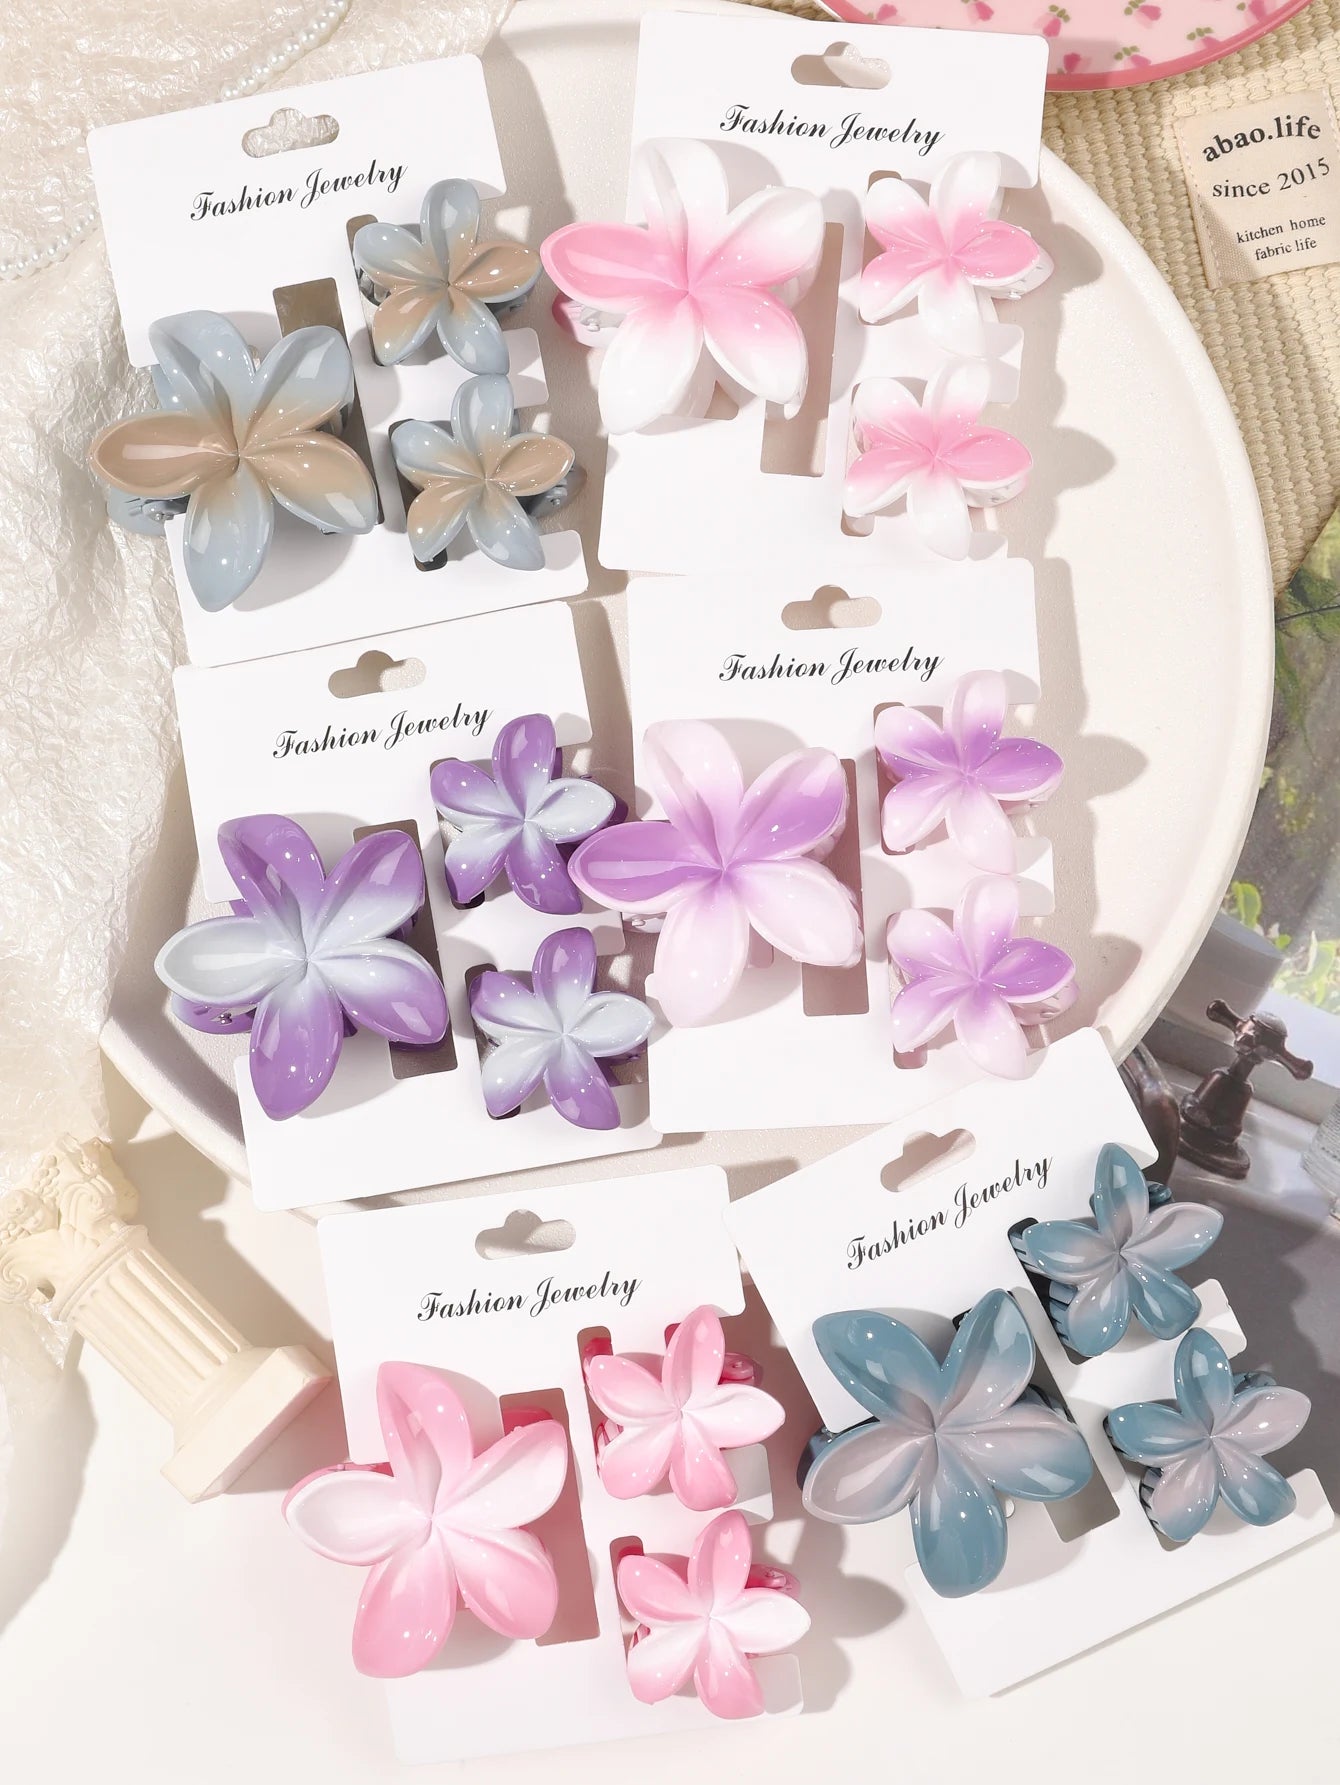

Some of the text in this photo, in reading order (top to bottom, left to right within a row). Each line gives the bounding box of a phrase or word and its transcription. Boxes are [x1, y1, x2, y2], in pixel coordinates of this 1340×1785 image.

[720, 104, 946, 157] Fashion Jewelry
[1202, 114, 1321, 162] abao.life
[190, 158, 408, 221] Fashion Jewelry
[1212, 157, 1330, 198] since 2015
[1236, 215, 1327, 244] kitchen home
[1255, 237, 1318, 261] fabric life
[718, 646, 944, 685] Fashion Jewelry
[272, 702, 493, 760] Fashion Jewelry
[847, 1155, 1053, 1271] Fashion Jewelry
[417, 1271, 642, 1322] Fashion Jewelry
